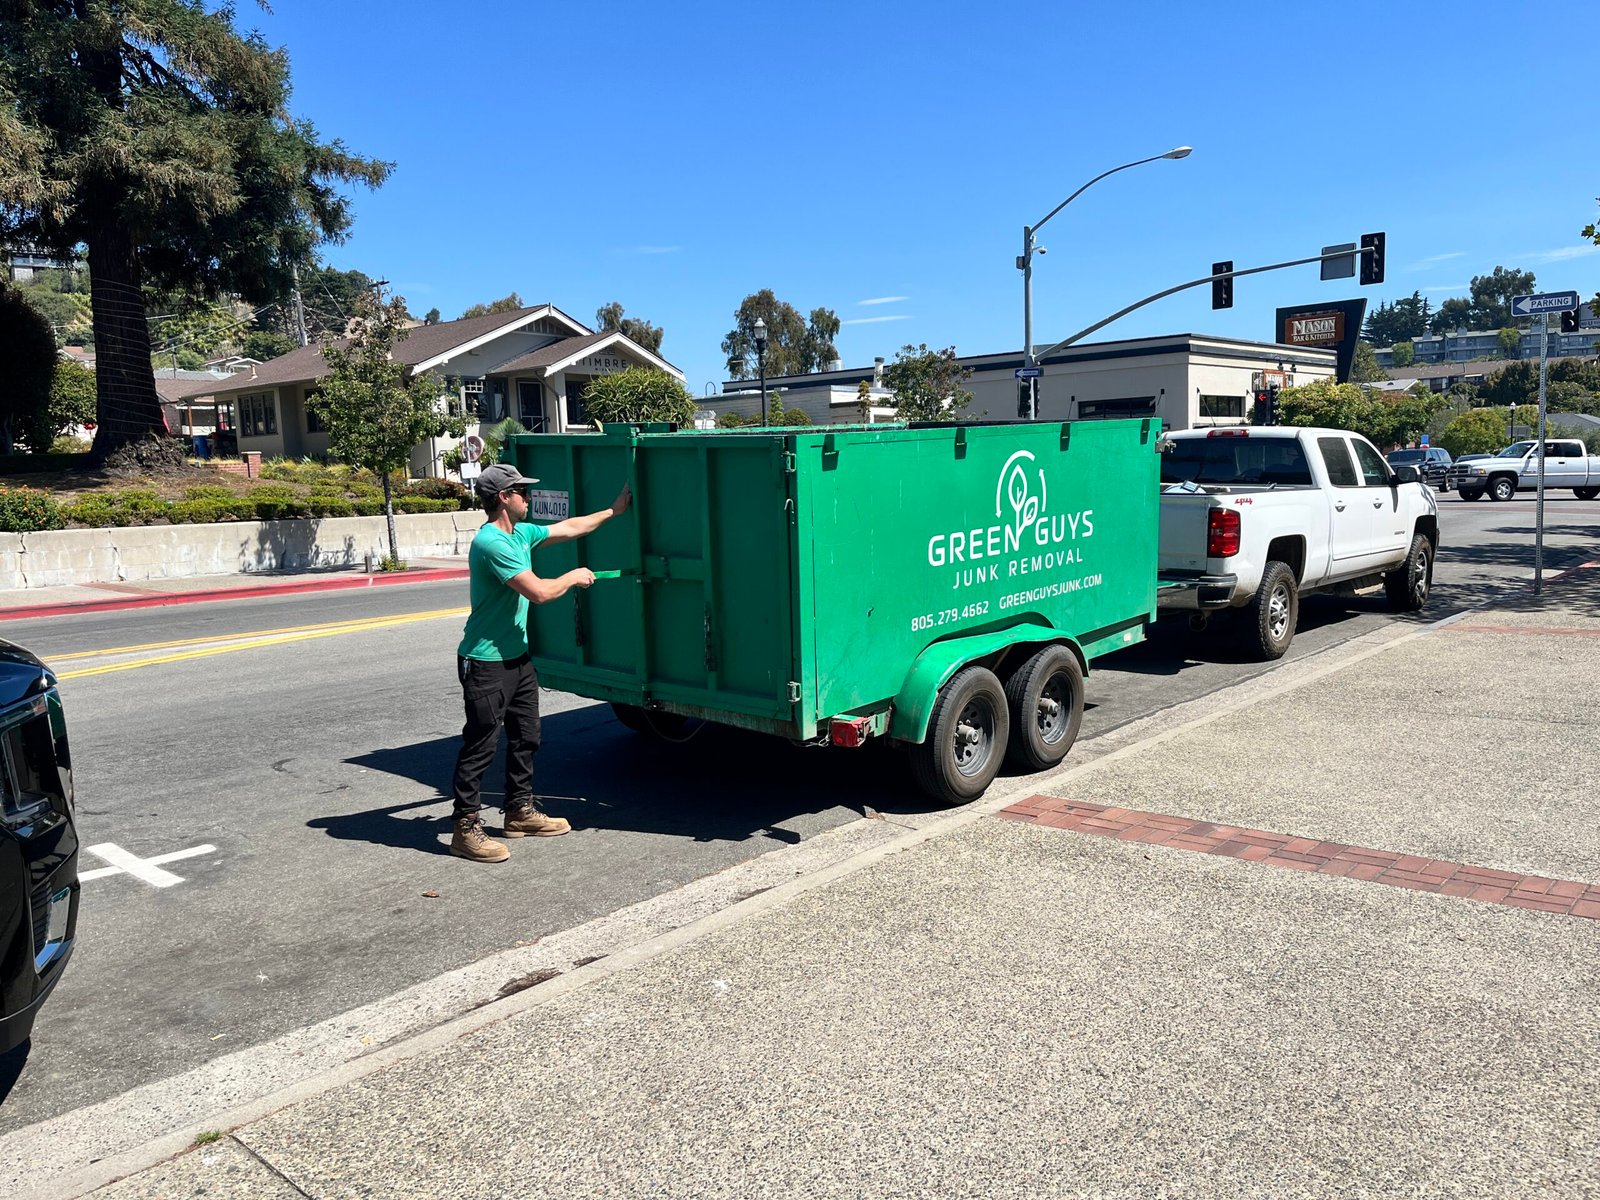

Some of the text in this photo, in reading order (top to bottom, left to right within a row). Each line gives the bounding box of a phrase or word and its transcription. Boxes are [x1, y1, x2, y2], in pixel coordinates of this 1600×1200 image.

[1531, 298, 1569, 308] PARKING
[1291, 319, 1336, 336] MASON
[1310, 332, 1336, 341] KITCHEN
[582, 357, 627, 368] TIMBRE
[534, 501, 567, 516] 4UN4018
[928, 510, 1093, 566] GREEN GUYS
[953, 548, 1083, 589] JUNK REMOVAL
[911, 573, 1102, 631] 805.279.4662 GREENGUYSJUNK.COM
